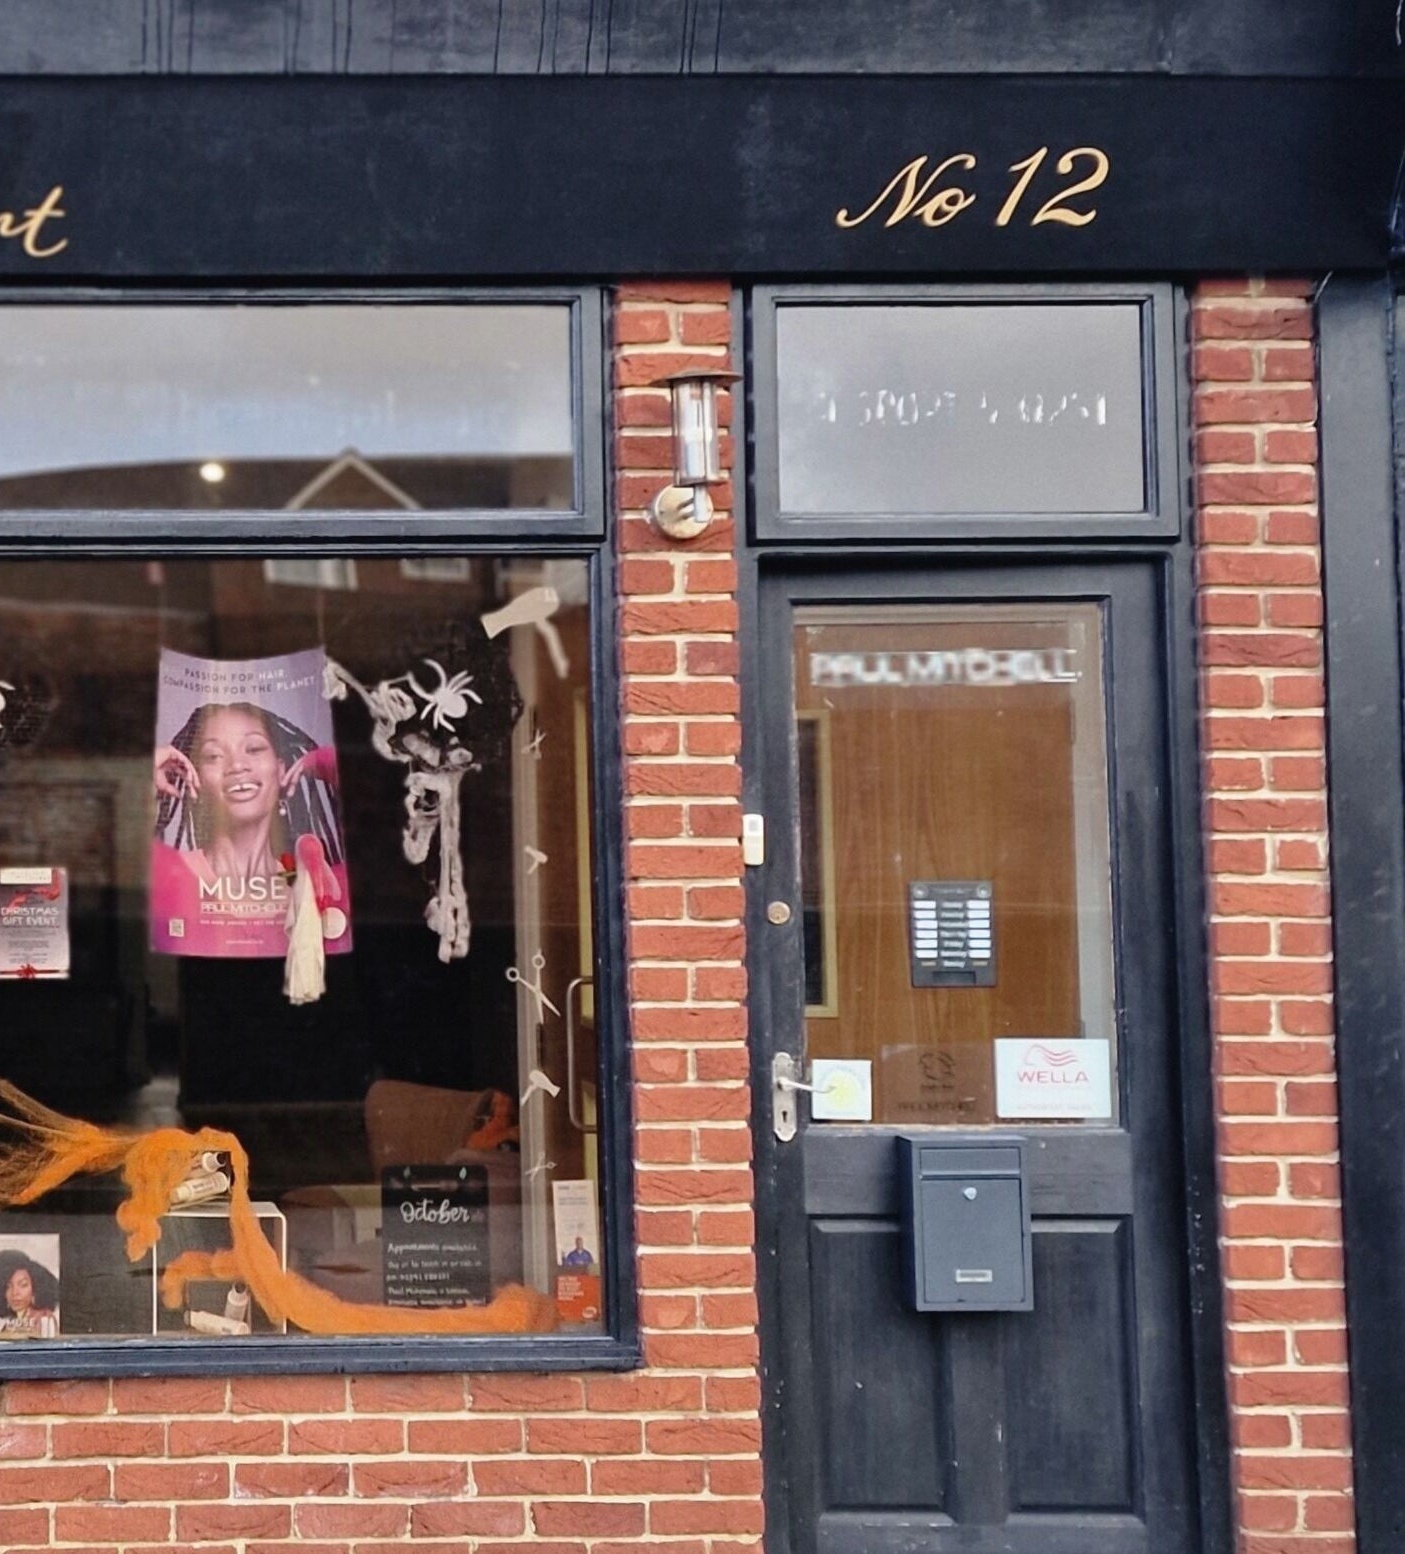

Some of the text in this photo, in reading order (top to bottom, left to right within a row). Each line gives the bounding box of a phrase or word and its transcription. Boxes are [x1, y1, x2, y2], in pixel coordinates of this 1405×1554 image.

[836, 146, 1109, 228] No 12
[184, 667, 227, 682] PASSION
[231, 672, 254, 682] FOR
[811, 648, 1079, 686] PAUL MITCHELL
[162, 675, 220, 694] COMPASSION
[224, 686, 246, 695] FOR
[252, 684, 273, 693] THE
[198, 876, 287, 901] MUSE
[0, 906, 60, 917] CHRISTMAS
[201, 901, 226, 914] PAUL
[2, 916, 56, 926] GIFT EVENT
[1017, 1070, 1089, 1084] WELLA
[399, 1198, 470, 1225] October
[6, 1318, 36, 1328] MUSE
